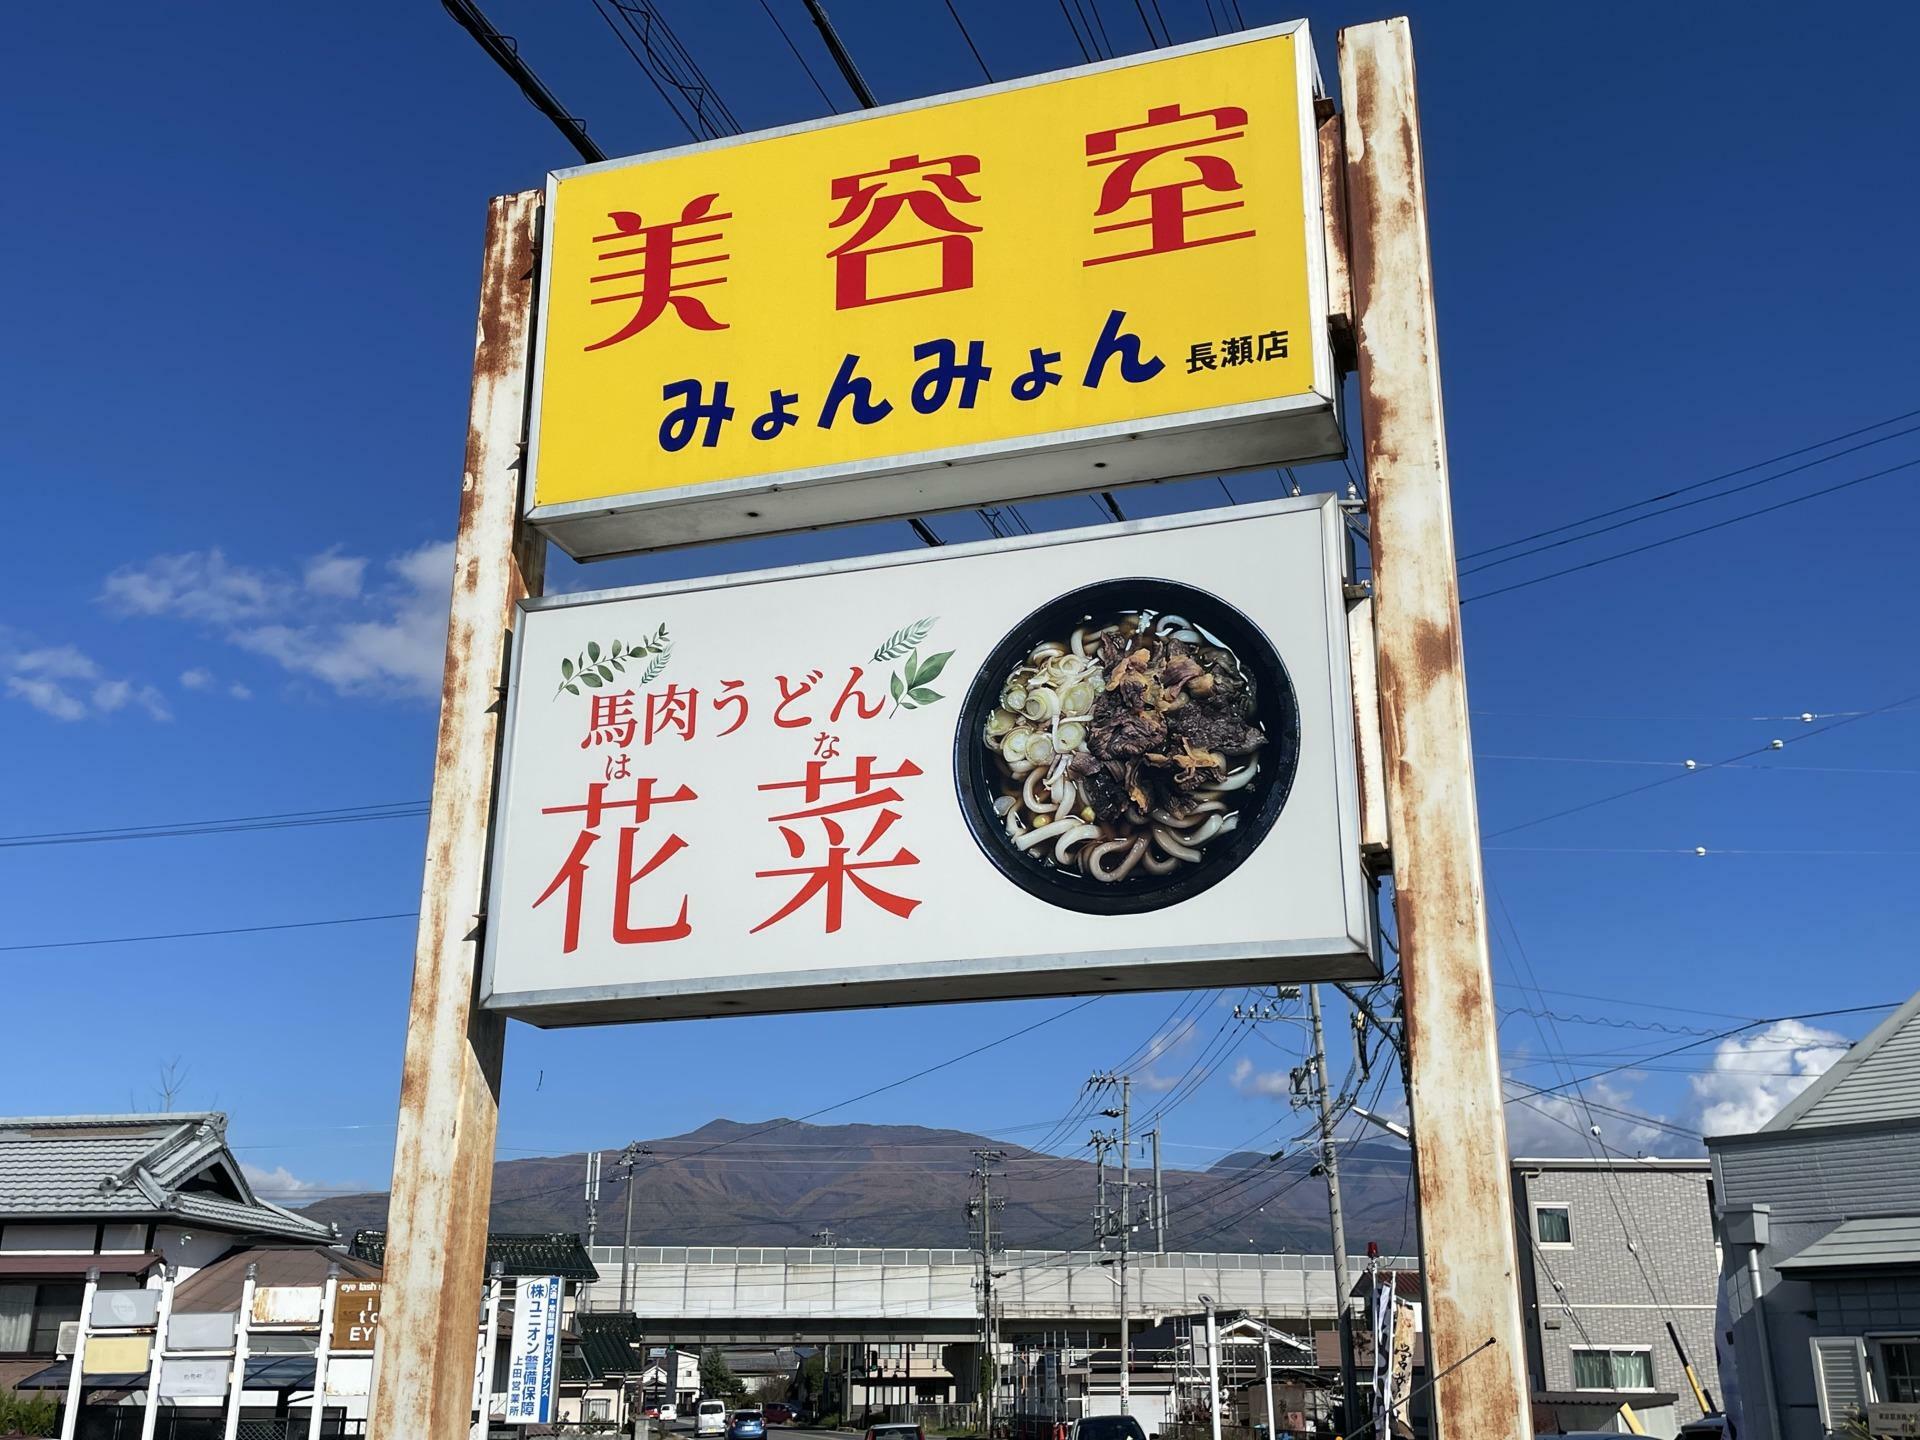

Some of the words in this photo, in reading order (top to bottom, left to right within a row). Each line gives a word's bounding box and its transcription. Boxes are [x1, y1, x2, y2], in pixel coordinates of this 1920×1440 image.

[584, 103, 1257, 352] 美容室
[658, 309, 1165, 453] みょんみょん
[1186, 330, 1289, 375] 長瀬店
[581, 666, 887, 749] 馬肉うどん
[605, 753, 632, 780] は
[813, 731, 840, 759] な
[532, 755, 924, 954] 花菜
[341, 1284, 357, 1293] eye
[359, 1282, 377, 1291] lash
[350, 1326, 374, 1342] EY
[520, 1283, 549, 1417] (株)ユニオン警備保障
[509, 1355, 523, 1417] 上田営業所
